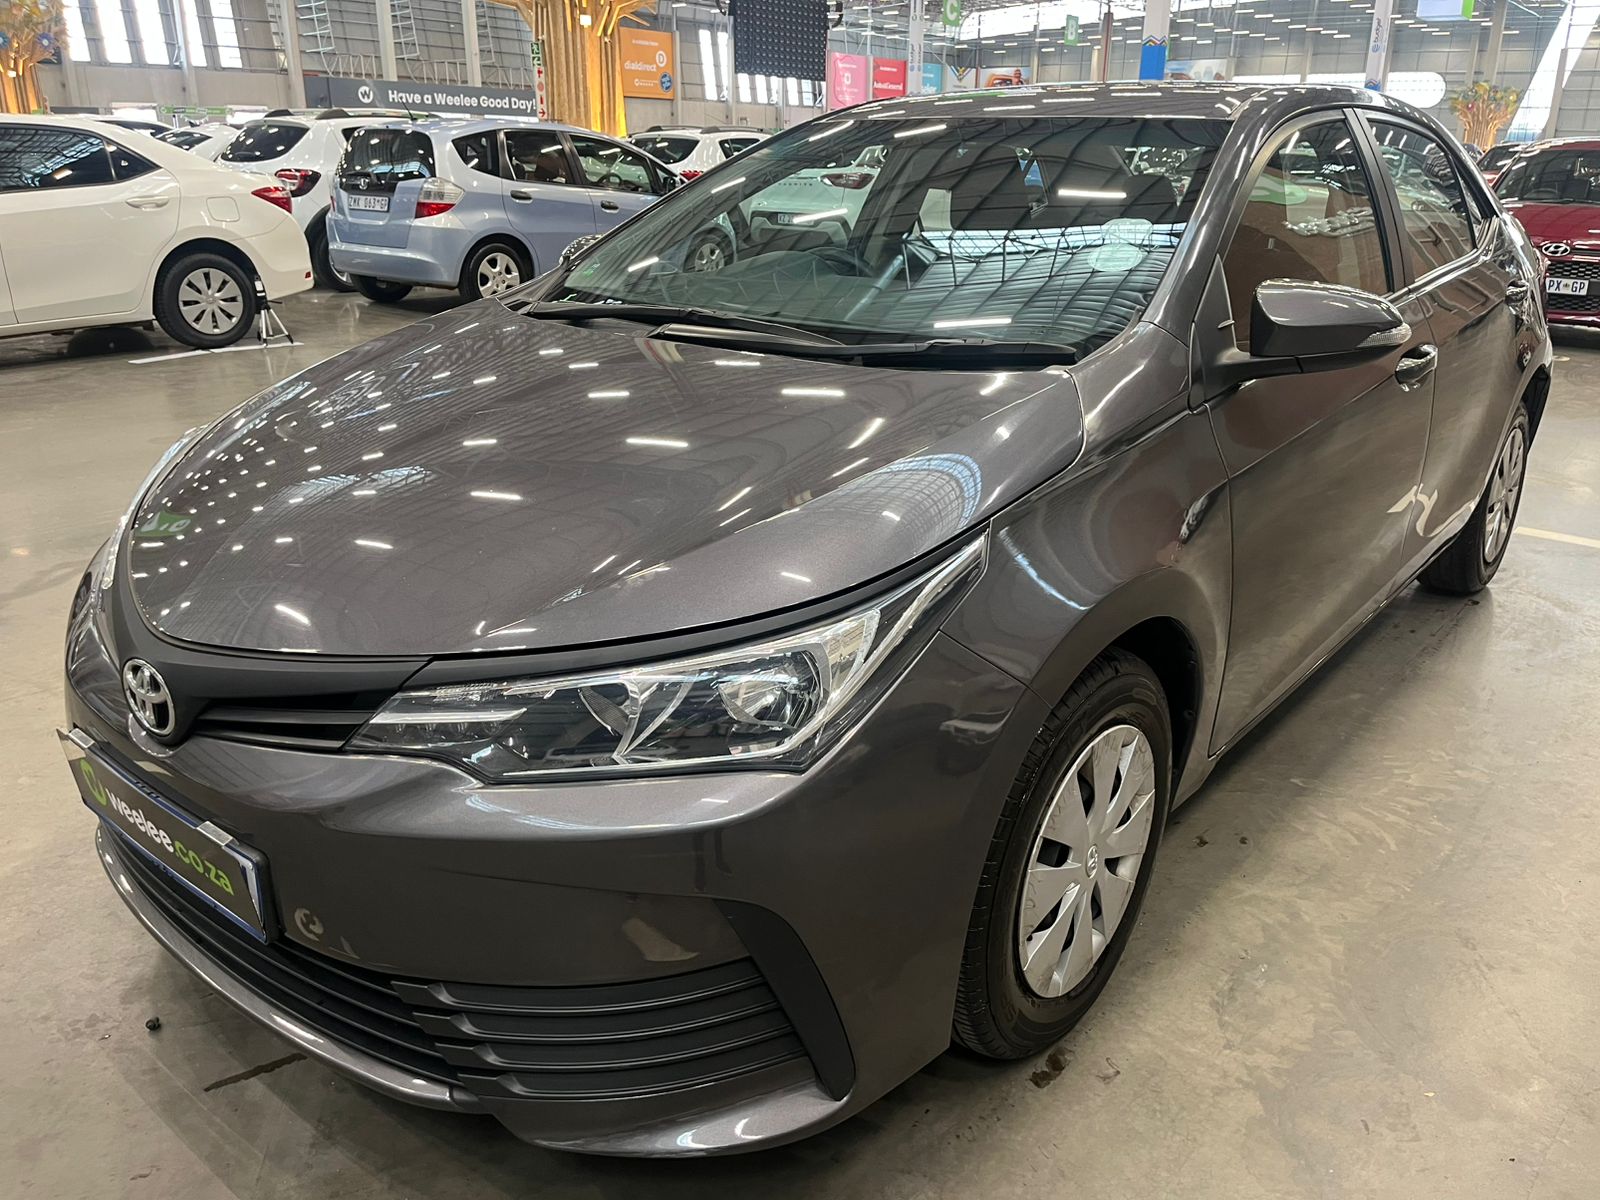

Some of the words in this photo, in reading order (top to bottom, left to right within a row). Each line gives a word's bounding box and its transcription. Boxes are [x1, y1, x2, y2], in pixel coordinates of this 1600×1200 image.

[946, 0, 957, 20] C
[1066, 18, 1076, 41] B
[624, 60, 657, 72] dialdirect
[388, 89, 421, 104] Have
[423, 94, 432, 104] a
[433, 92, 479, 106] Weelee
[479, 96, 510, 109] Good
[511, 98, 537, 112] Day!
[1548, 280, 1562, 291] PX
[1571, 281, 1585, 293] GP
[105, 788, 235, 896] weelee.co.za
